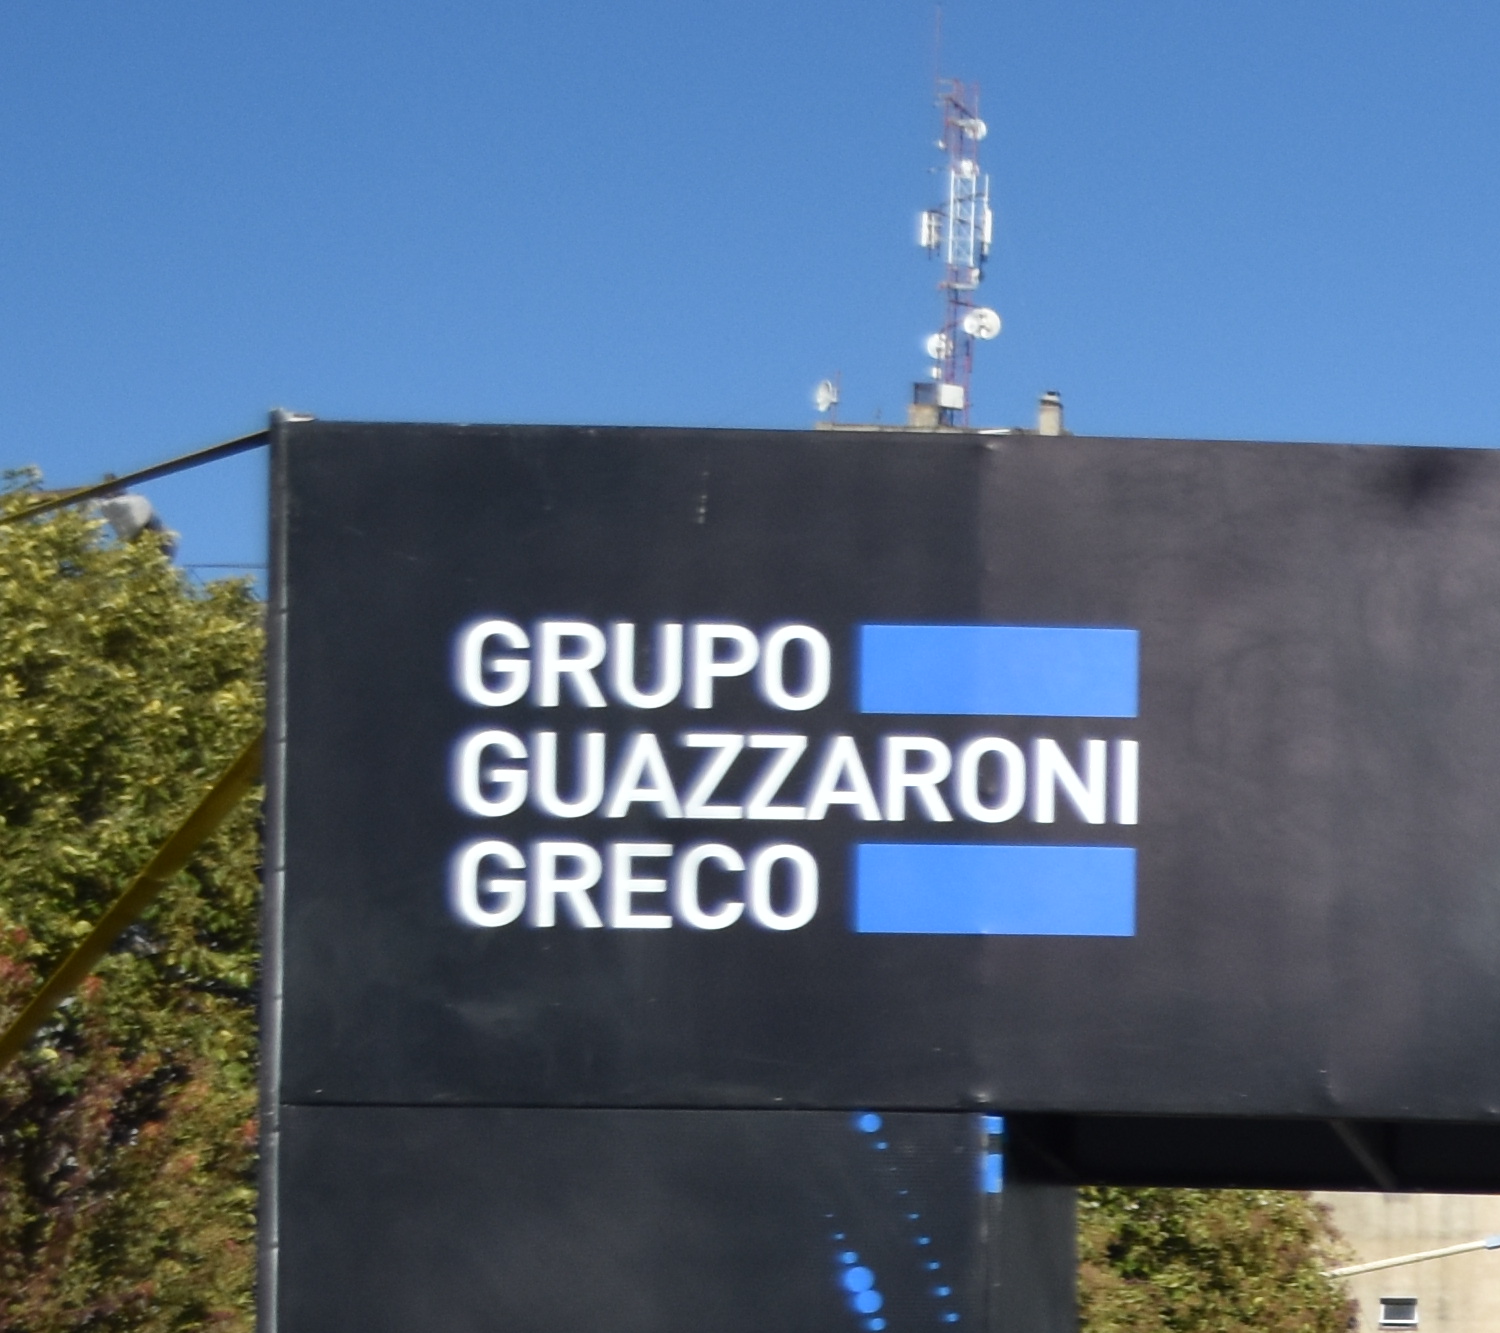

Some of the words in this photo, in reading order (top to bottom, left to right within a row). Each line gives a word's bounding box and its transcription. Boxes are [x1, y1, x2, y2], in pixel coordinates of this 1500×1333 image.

[456, 621, 831, 710] GRUPO
[455, 731, 1139, 825] GUAZZARONI
[453, 842, 820, 931] GRECO
